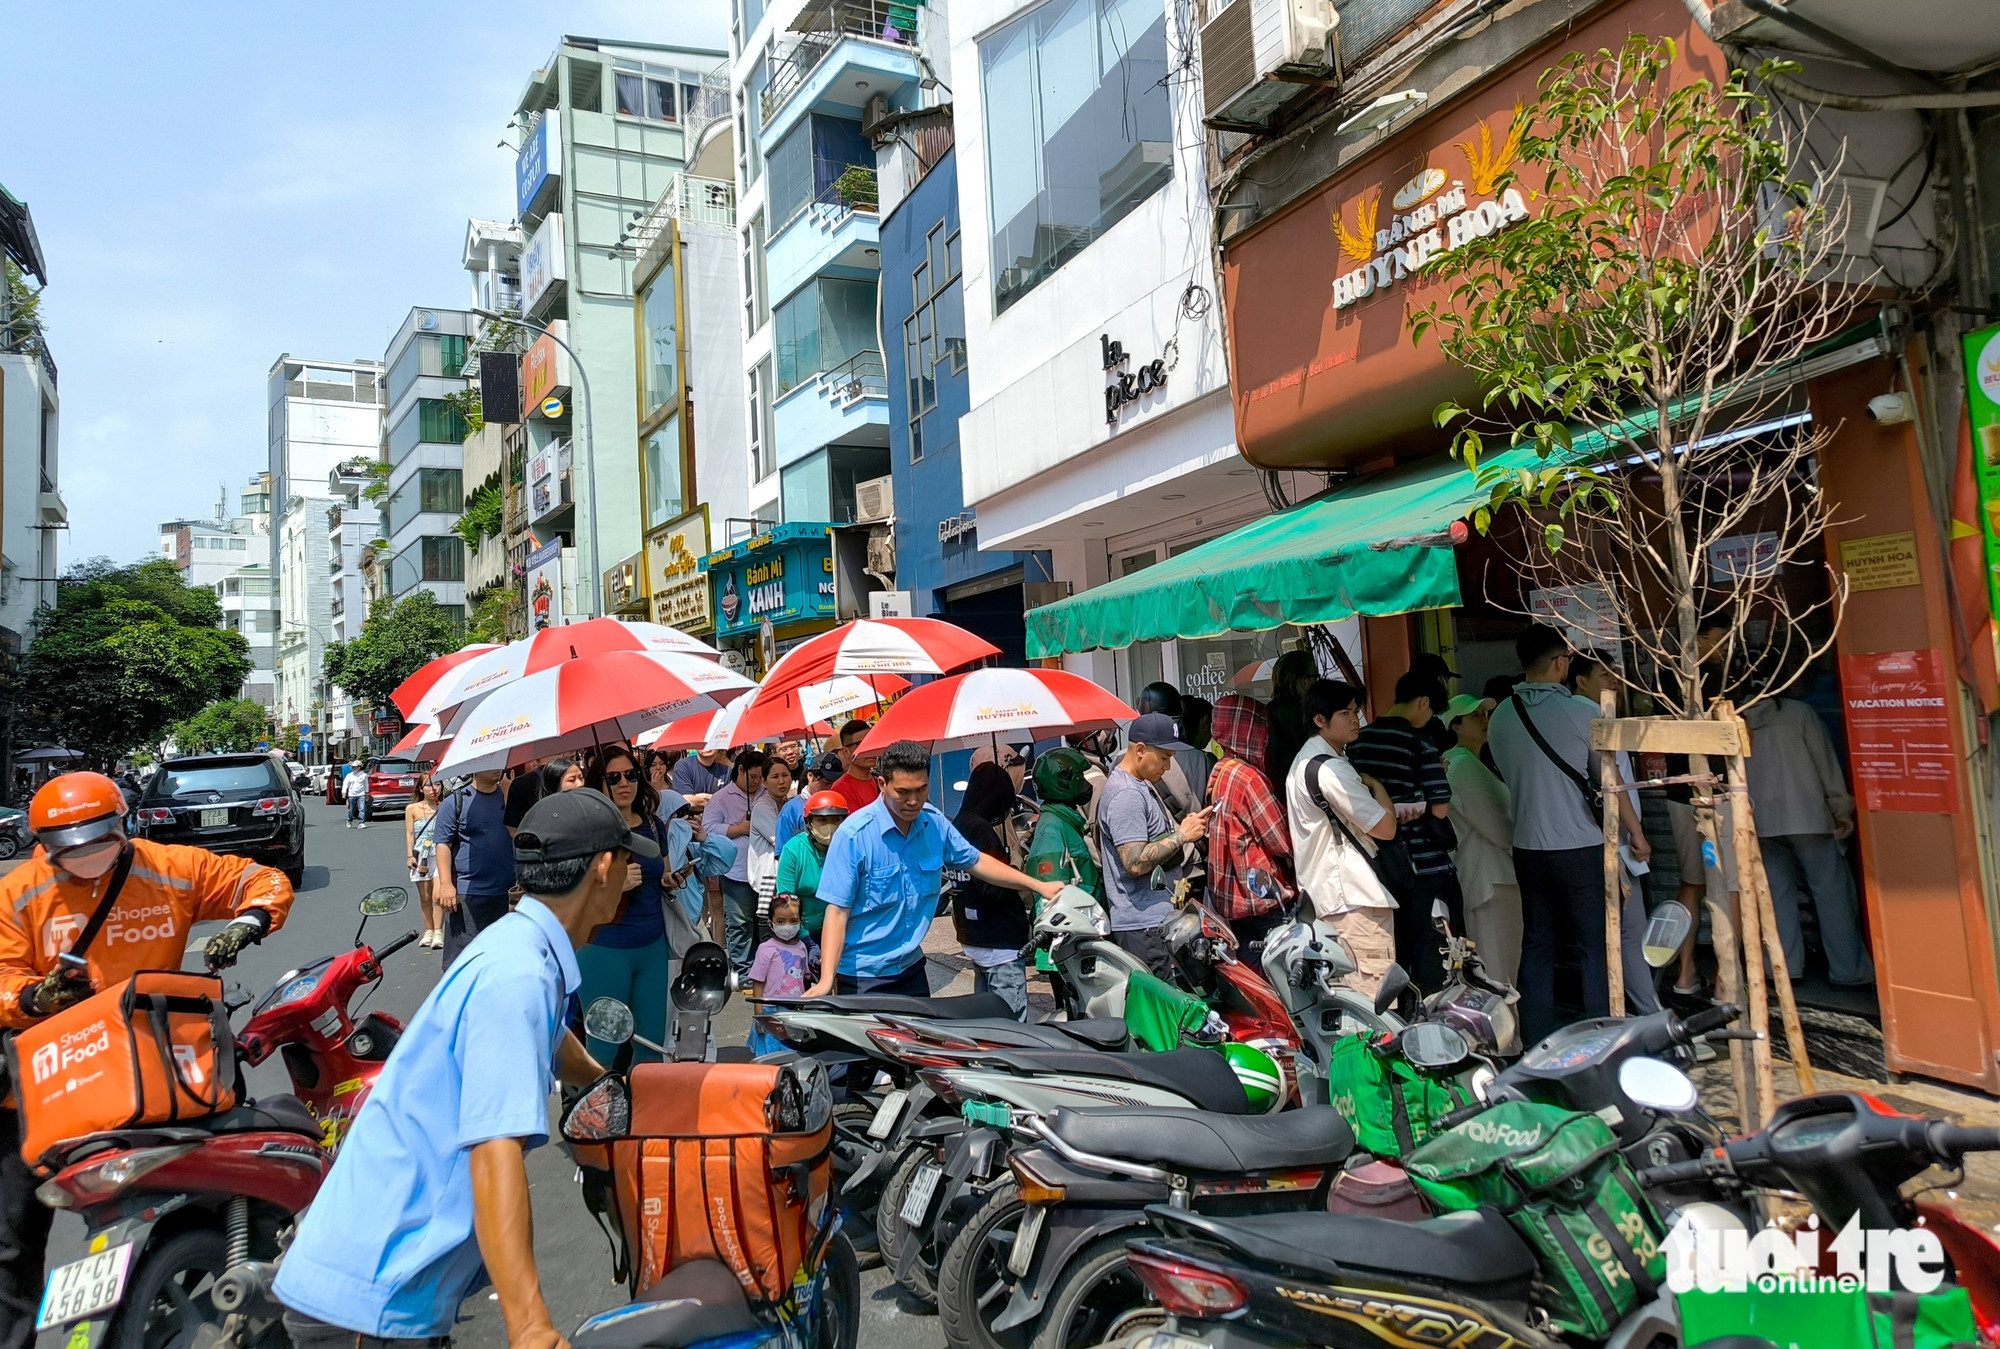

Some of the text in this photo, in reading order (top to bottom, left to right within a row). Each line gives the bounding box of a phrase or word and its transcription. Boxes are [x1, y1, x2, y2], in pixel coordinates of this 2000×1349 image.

[1447, 188, 1531, 252] HOA
[530, 345, 546, 372] Relax
[1104, 358, 1168, 425] piece
[746, 554, 783, 587] Bánh Mì
[1887, 551, 1914, 563] HOA
[747, 581, 785, 614] XANH
[1186, 664, 1226, 688] coffee
[1849, 697, 1945, 709] VACATION NOTICE
[207, 810, 221, 818] 72A
[106, 903, 171, 923] Shopee
[106, 916, 176, 947] Food
[60, 1019, 106, 1050] Shopee
[61, 1030, 110, 1071] Food
[1449, 1120, 1542, 1148] rabFood
